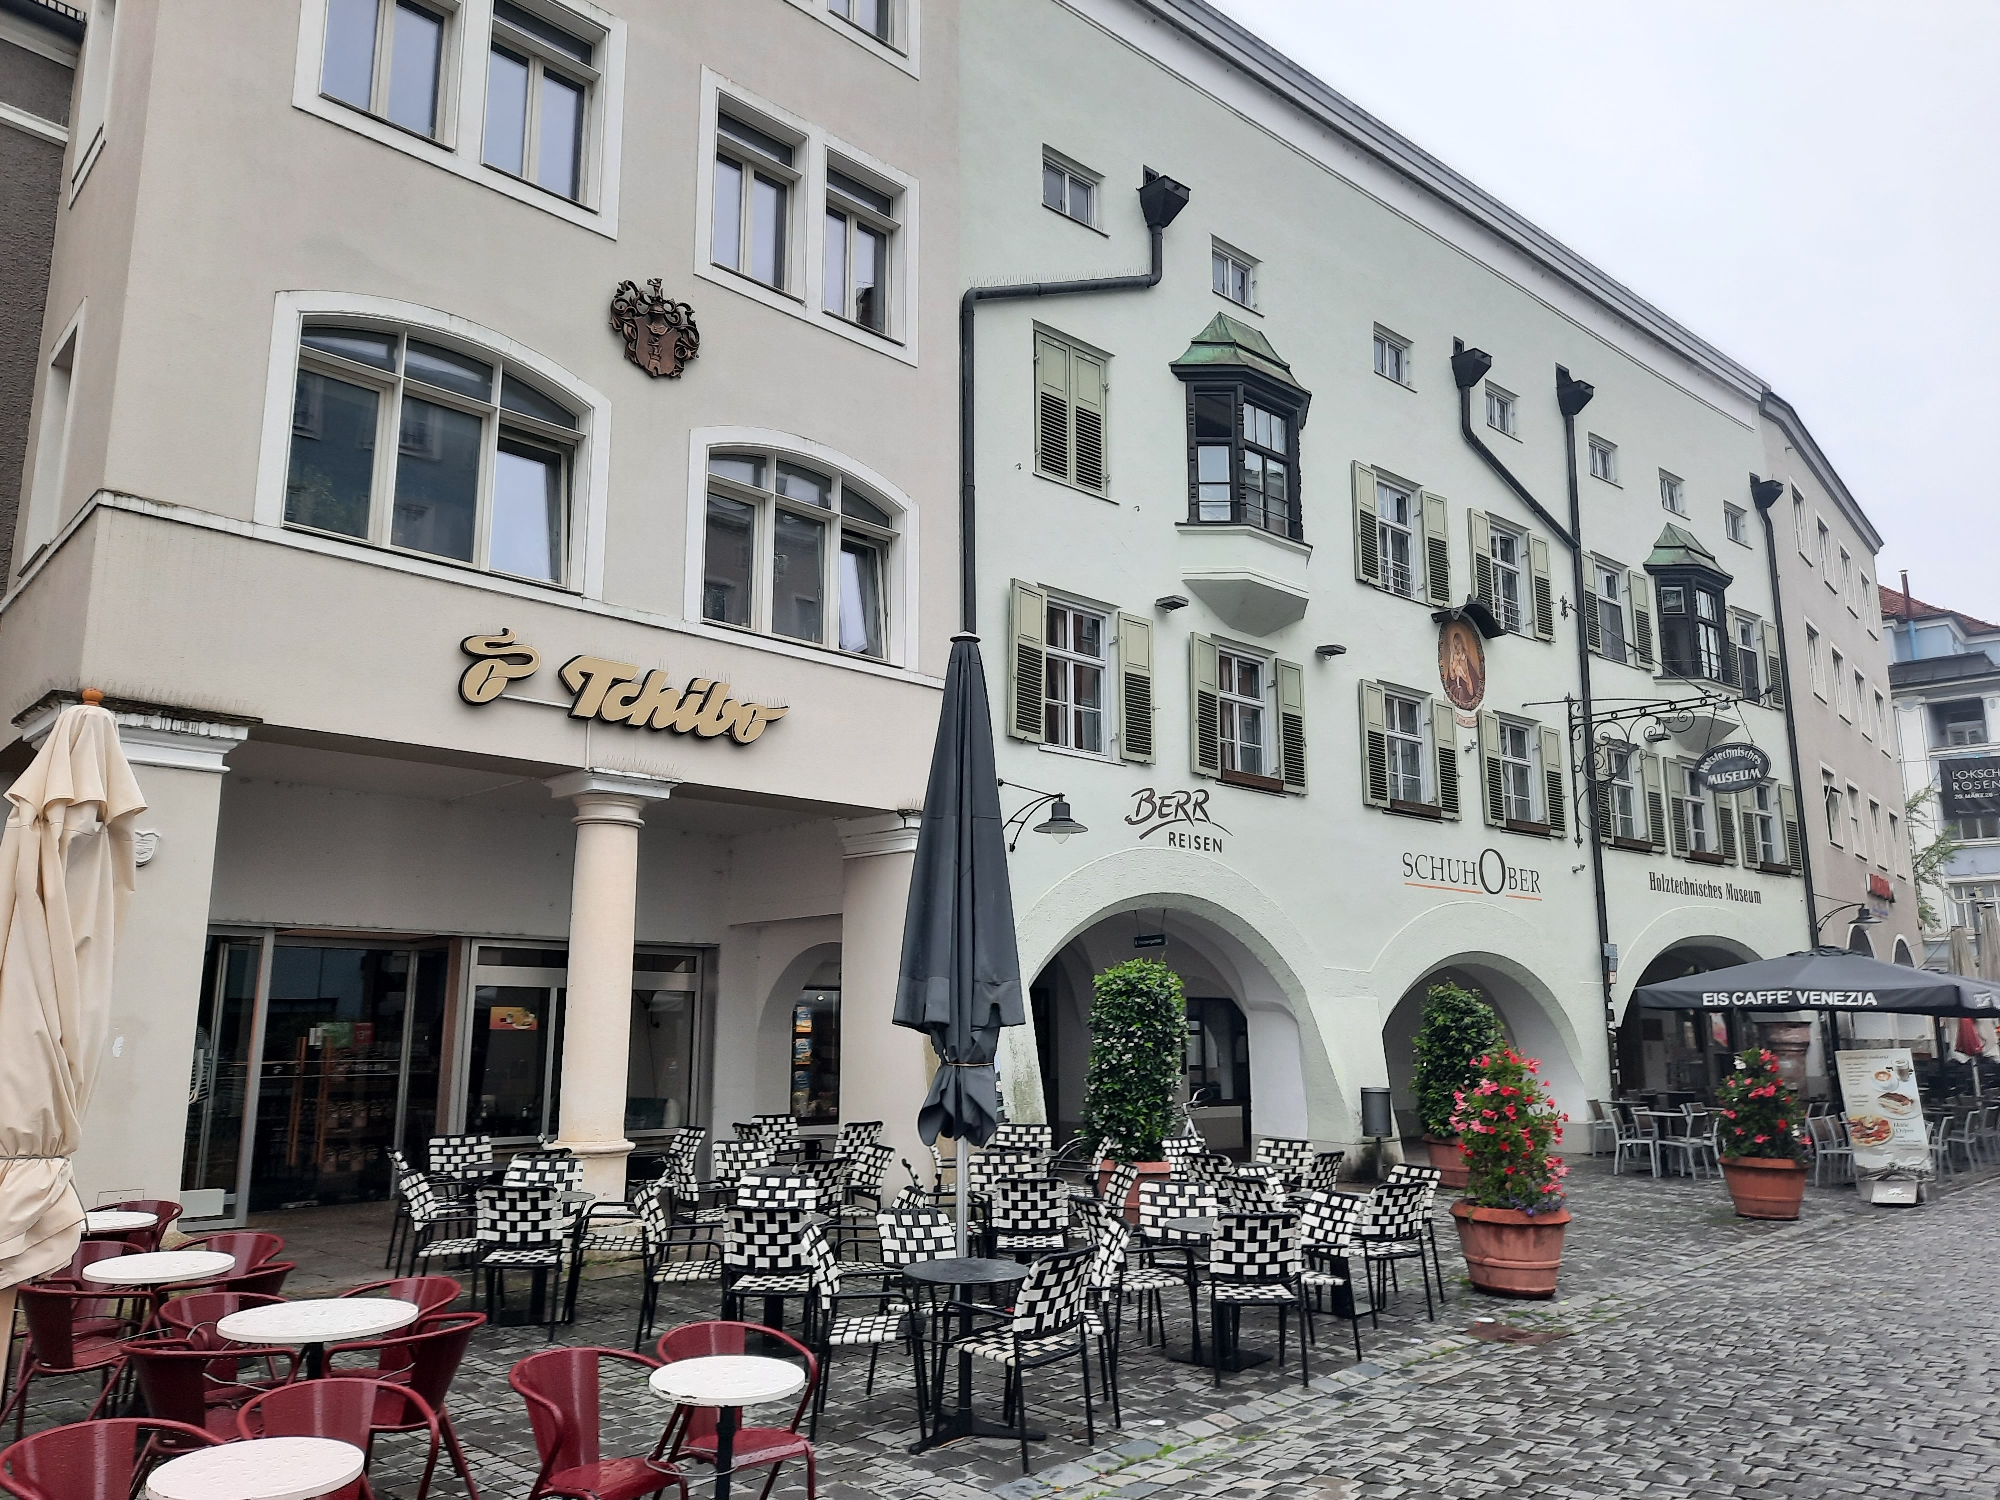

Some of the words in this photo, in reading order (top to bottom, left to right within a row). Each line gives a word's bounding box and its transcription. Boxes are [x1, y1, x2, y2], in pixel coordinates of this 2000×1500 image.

[558, 654, 790, 745] Tchibo
[1706, 767, 1762, 786] MUSEUM
[1123, 787, 1212, 827] BERR
[1168, 831, 1223, 854] REISEN
[1648, 871, 1724, 900] Holztechnisches
[1725, 882, 1762, 905] Museum
[1702, 992, 1730, 1006] EIS
[1731, 990, 1793, 1006] CAFFE'
[1795, 990, 1878, 1006] VENEZIA
